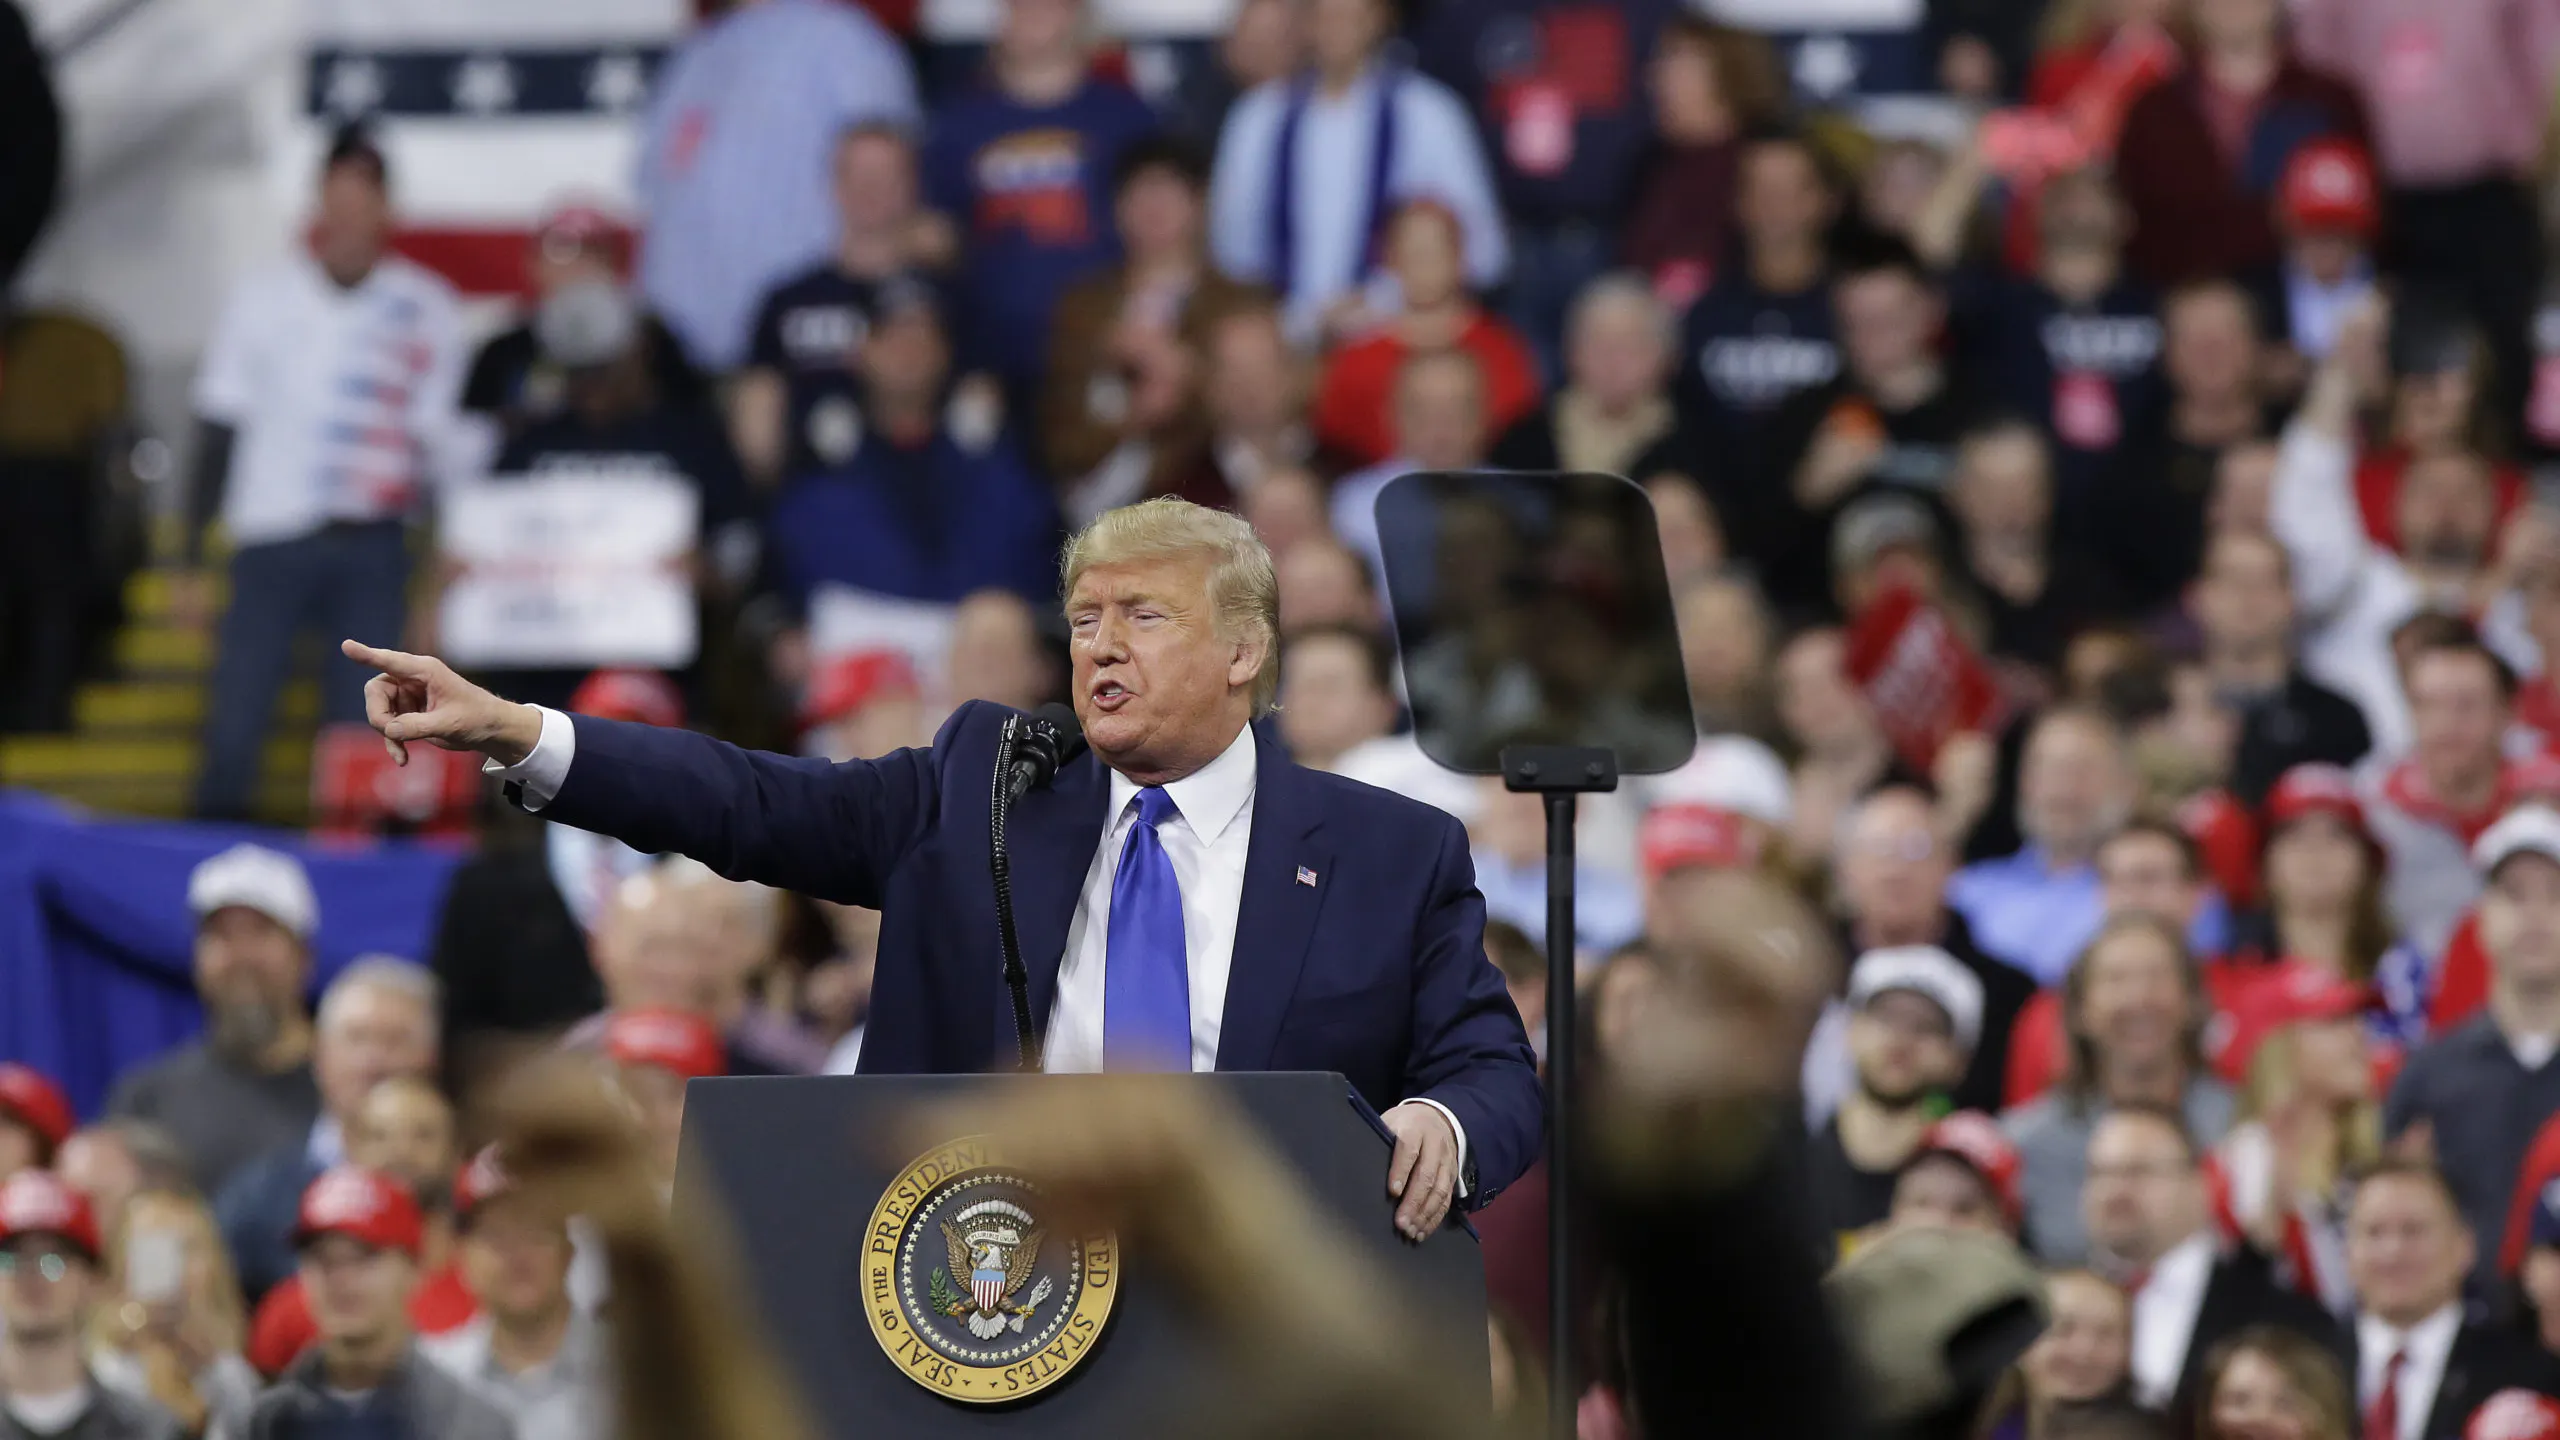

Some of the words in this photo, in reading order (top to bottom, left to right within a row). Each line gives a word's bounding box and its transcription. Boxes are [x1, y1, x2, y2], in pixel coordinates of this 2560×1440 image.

[872, 1266, 889, 1303] THE
[880, 1308, 899, 1331] OF
[895, 1329, 958, 1387] SEAL
[1003, 1312, 1095, 1391] STATES
